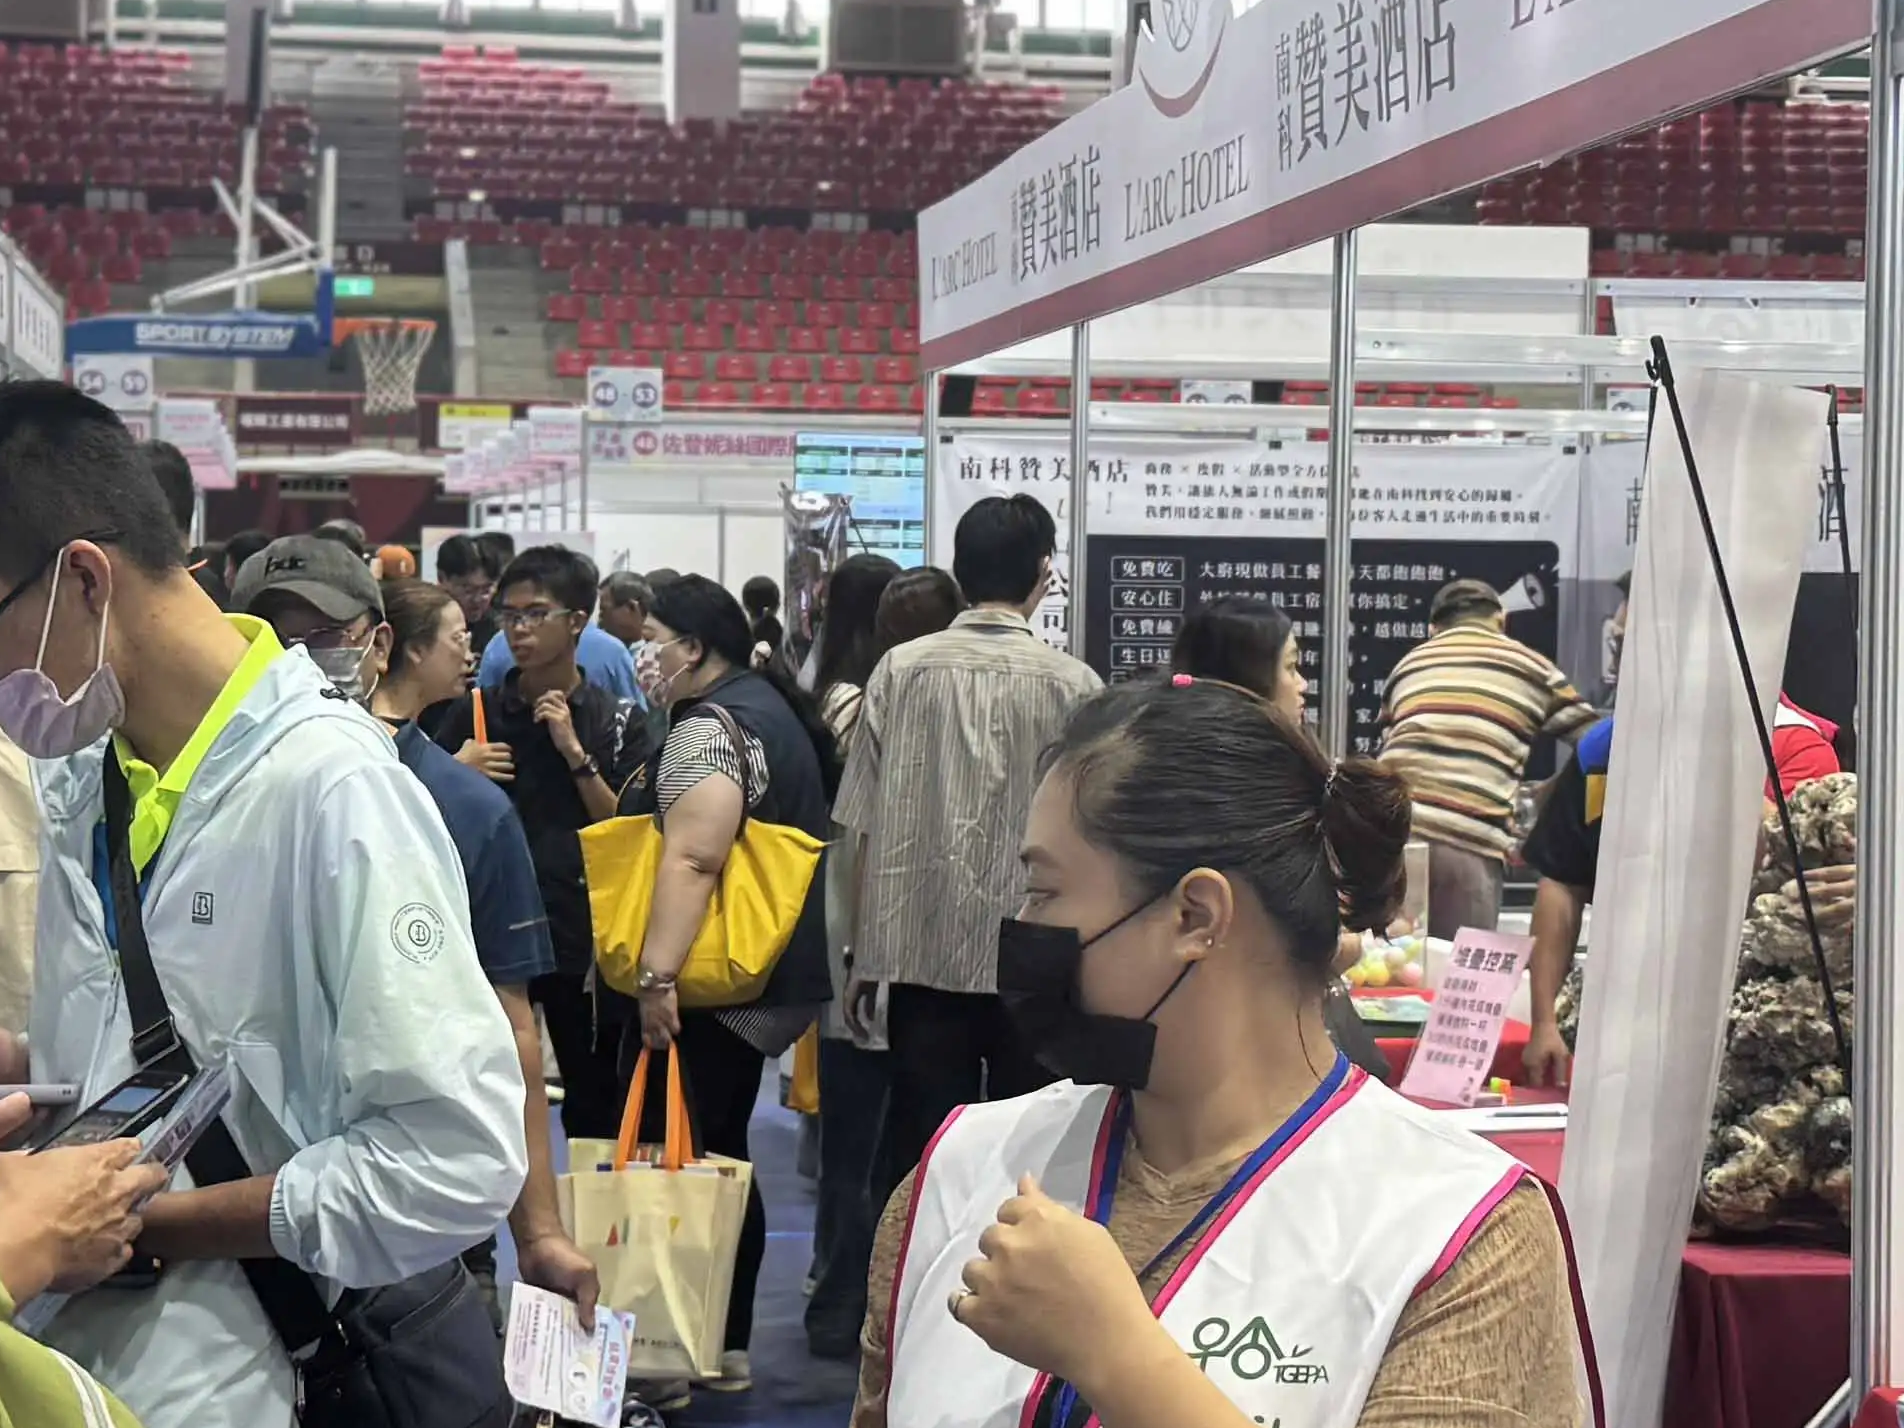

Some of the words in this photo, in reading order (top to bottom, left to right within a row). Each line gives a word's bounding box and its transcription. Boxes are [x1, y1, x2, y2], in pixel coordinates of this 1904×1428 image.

[1181, 134, 1251, 219] HOTEL
[595, 387, 616, 402] 48
[635, 387, 656, 403] 53
[1122, 560, 1174, 578] 免費吃
[1121, 590, 1174, 607] 安心住
